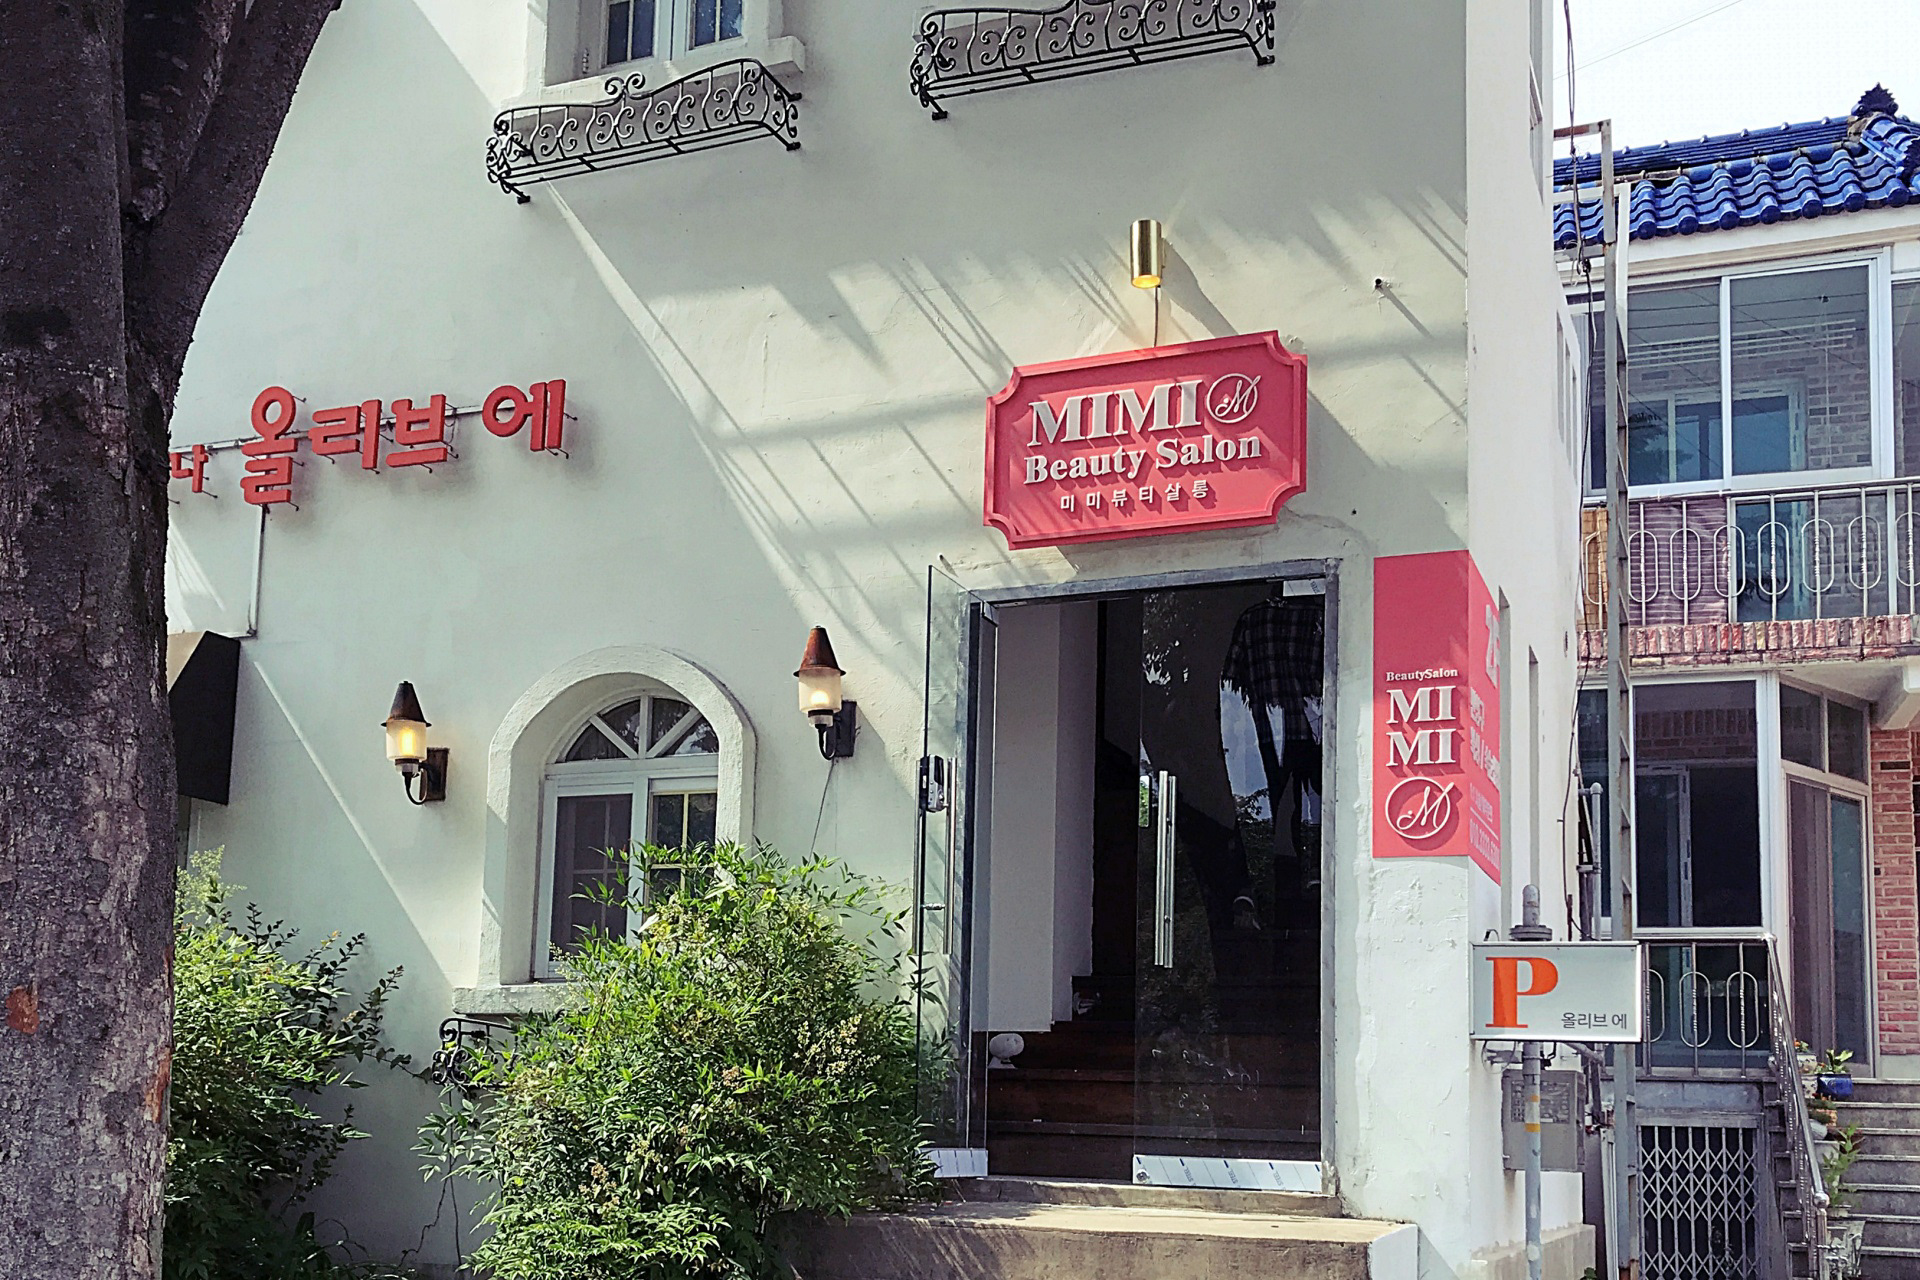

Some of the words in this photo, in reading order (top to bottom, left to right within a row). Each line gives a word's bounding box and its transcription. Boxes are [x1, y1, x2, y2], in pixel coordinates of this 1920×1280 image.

[1027, 379, 1203, 447] MIMI
[240, 386, 447, 505] 올리브
[481, 379, 566, 451] 에
[1024, 447, 1146, 485] Beauty
[1156, 434, 1261, 469] Salon
[1386, 685, 1456, 724] MI
[1386, 728, 1456, 767] MI
[1485, 956, 1559, 1028] P
[1560, 1012, 1608, 1029] 올리브
[1611, 1013, 1628, 1030] 에
